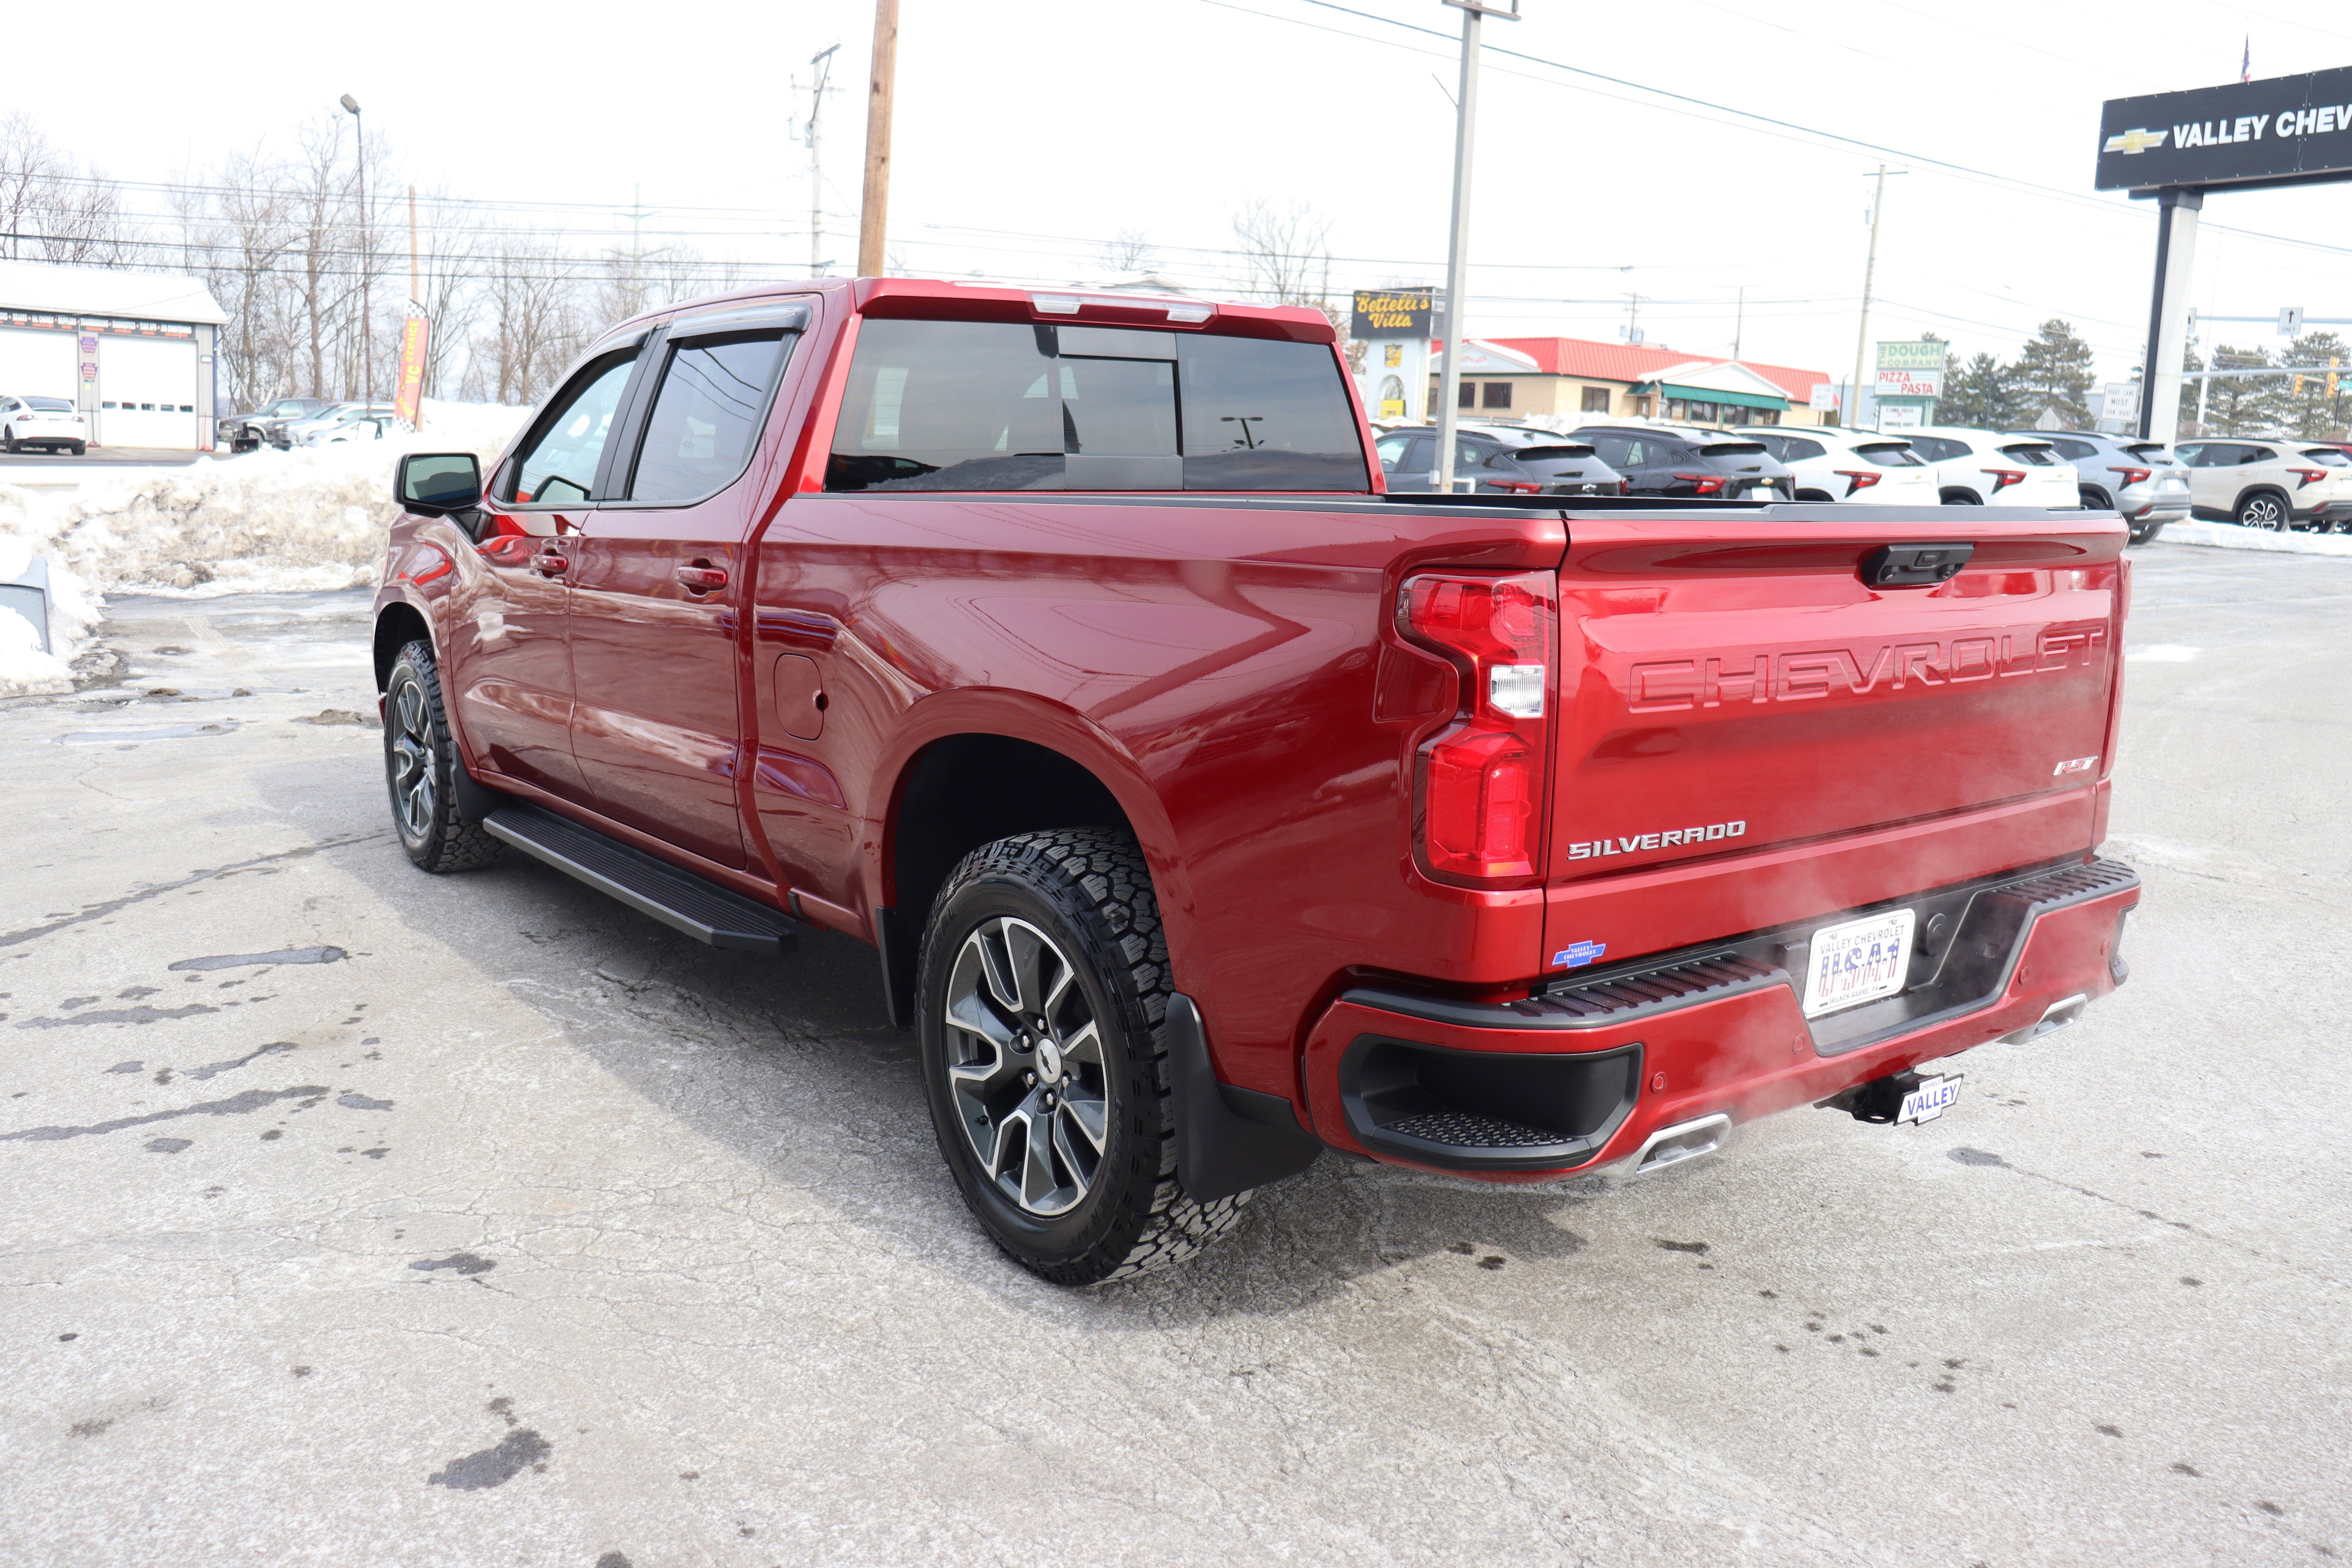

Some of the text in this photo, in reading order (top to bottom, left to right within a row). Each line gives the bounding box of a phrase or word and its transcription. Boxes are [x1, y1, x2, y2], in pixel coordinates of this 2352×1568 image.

[2173, 103, 2352, 149] VALLEY CHEV
[1368, 313, 1412, 328] Villa
[1889, 345, 1940, 356] DOUGH
[1879, 372, 1910, 383] PIZZA
[1901, 383, 1933, 394] PASTA
[1628, 627, 2104, 713] CHEVROLET
[2053, 756, 2098, 775] RST
[1567, 820, 1746, 860] SILVERADO
[1821, 924, 1905, 955] VALLEY CHEVROLET
[1564, 949, 1596, 960] CHEVROLET
[1570, 945, 1590, 953] VALLEY
[921, 905, 958, 1017] GENERAL
[1921, 1078, 1942, 1090] CHEVROLET
[1907, 1083, 1957, 1116] VALLEY
